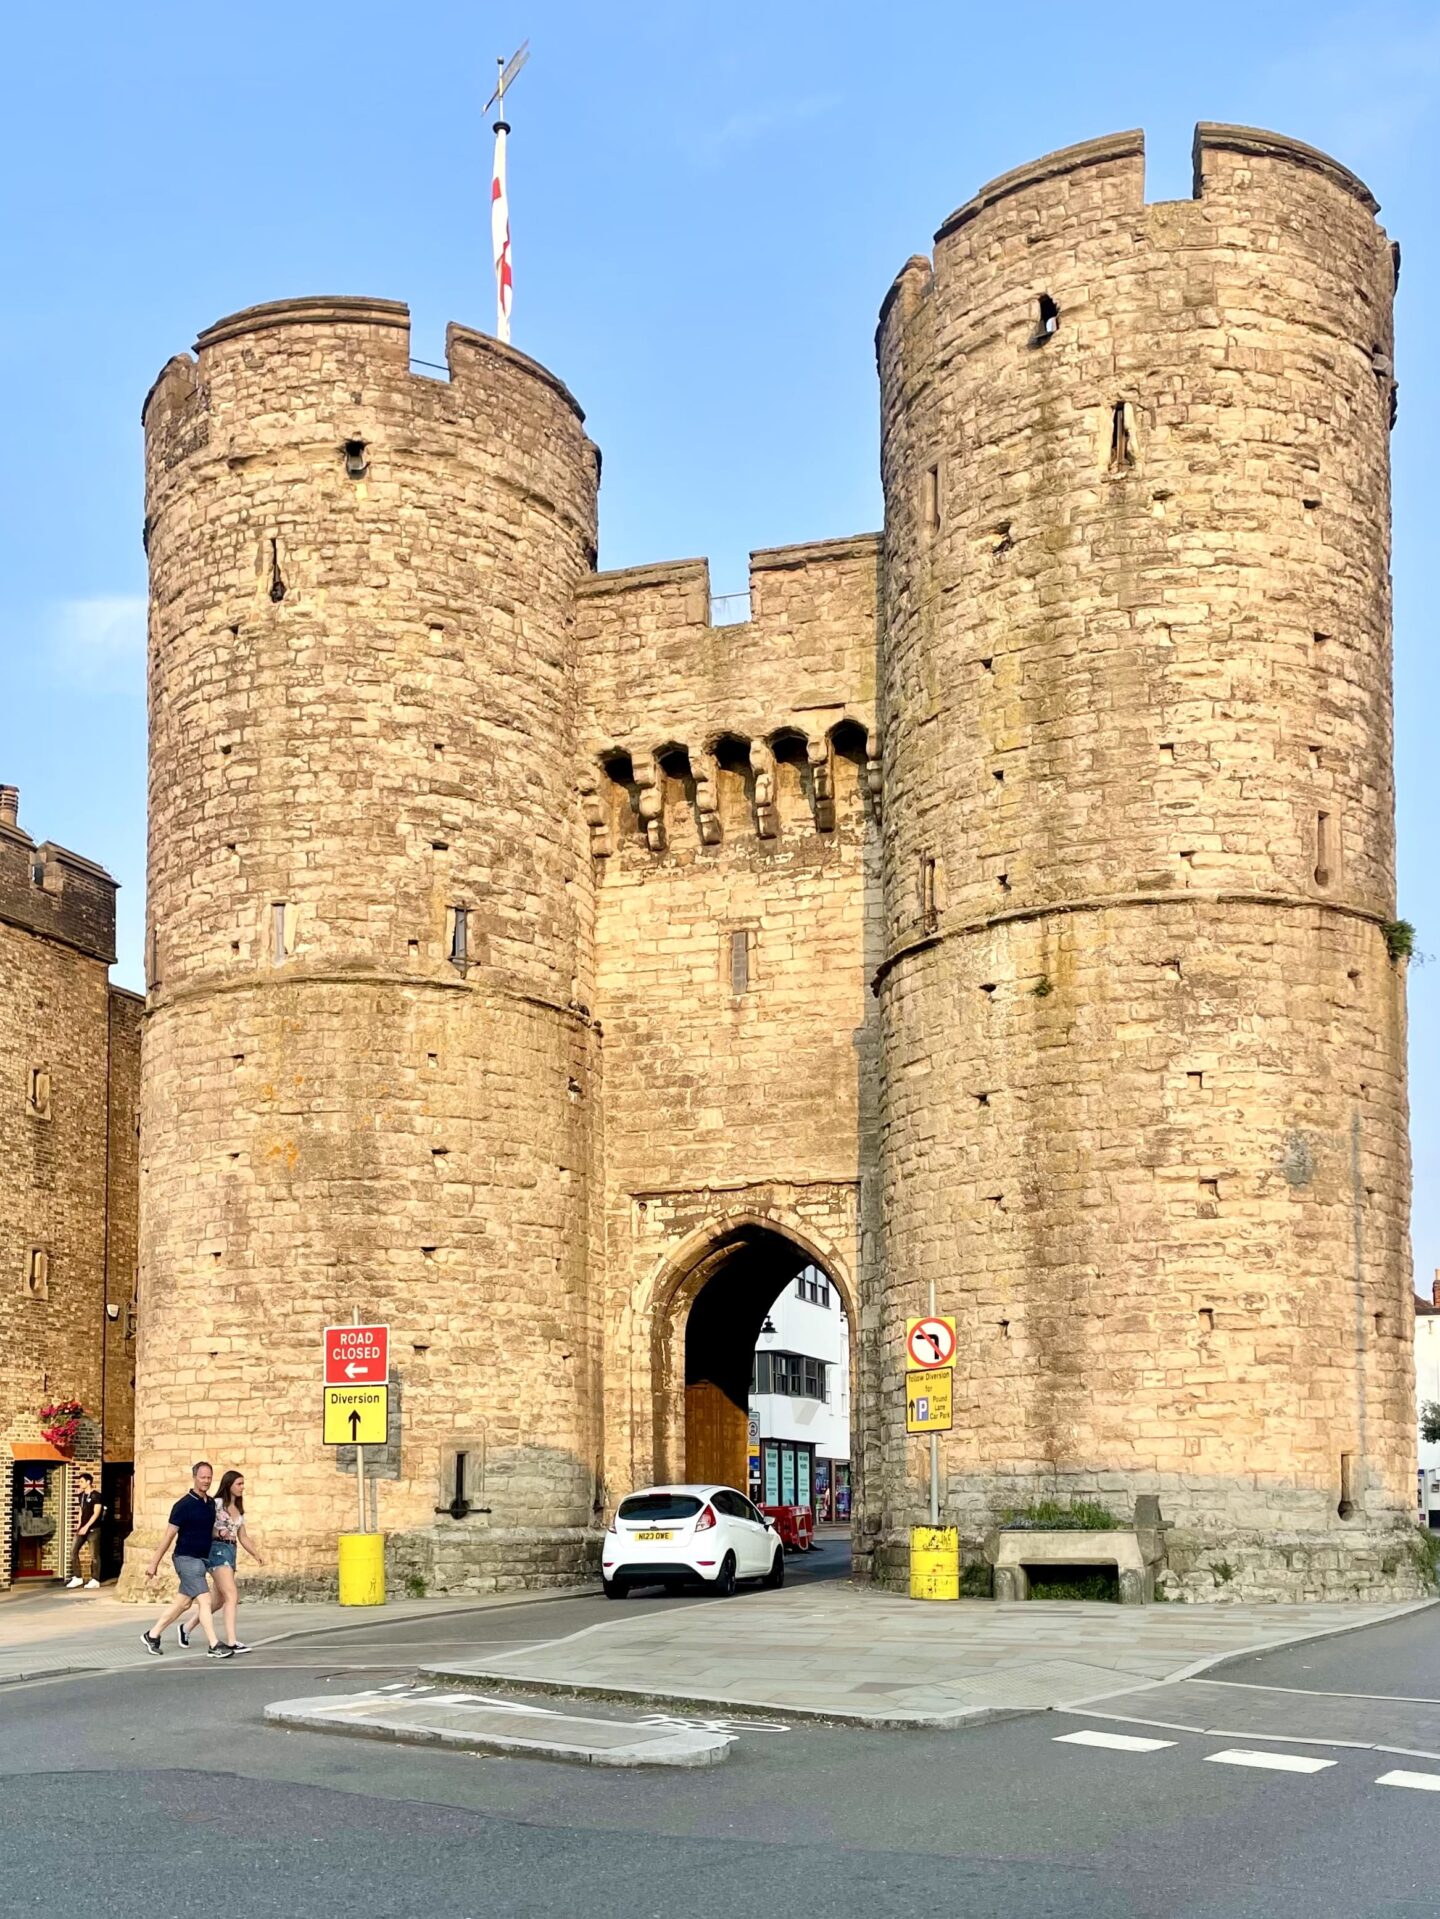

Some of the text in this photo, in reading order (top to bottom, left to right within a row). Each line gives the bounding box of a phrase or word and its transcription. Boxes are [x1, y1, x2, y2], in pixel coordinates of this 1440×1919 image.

[340, 1332, 374, 1345] ROAD
[332, 1347, 380, 1360] CLOSED
[925, 1372, 949, 1381] Diversion
[331, 1393, 380, 1404] Diversion
[919, 1400, 927, 1420] P
